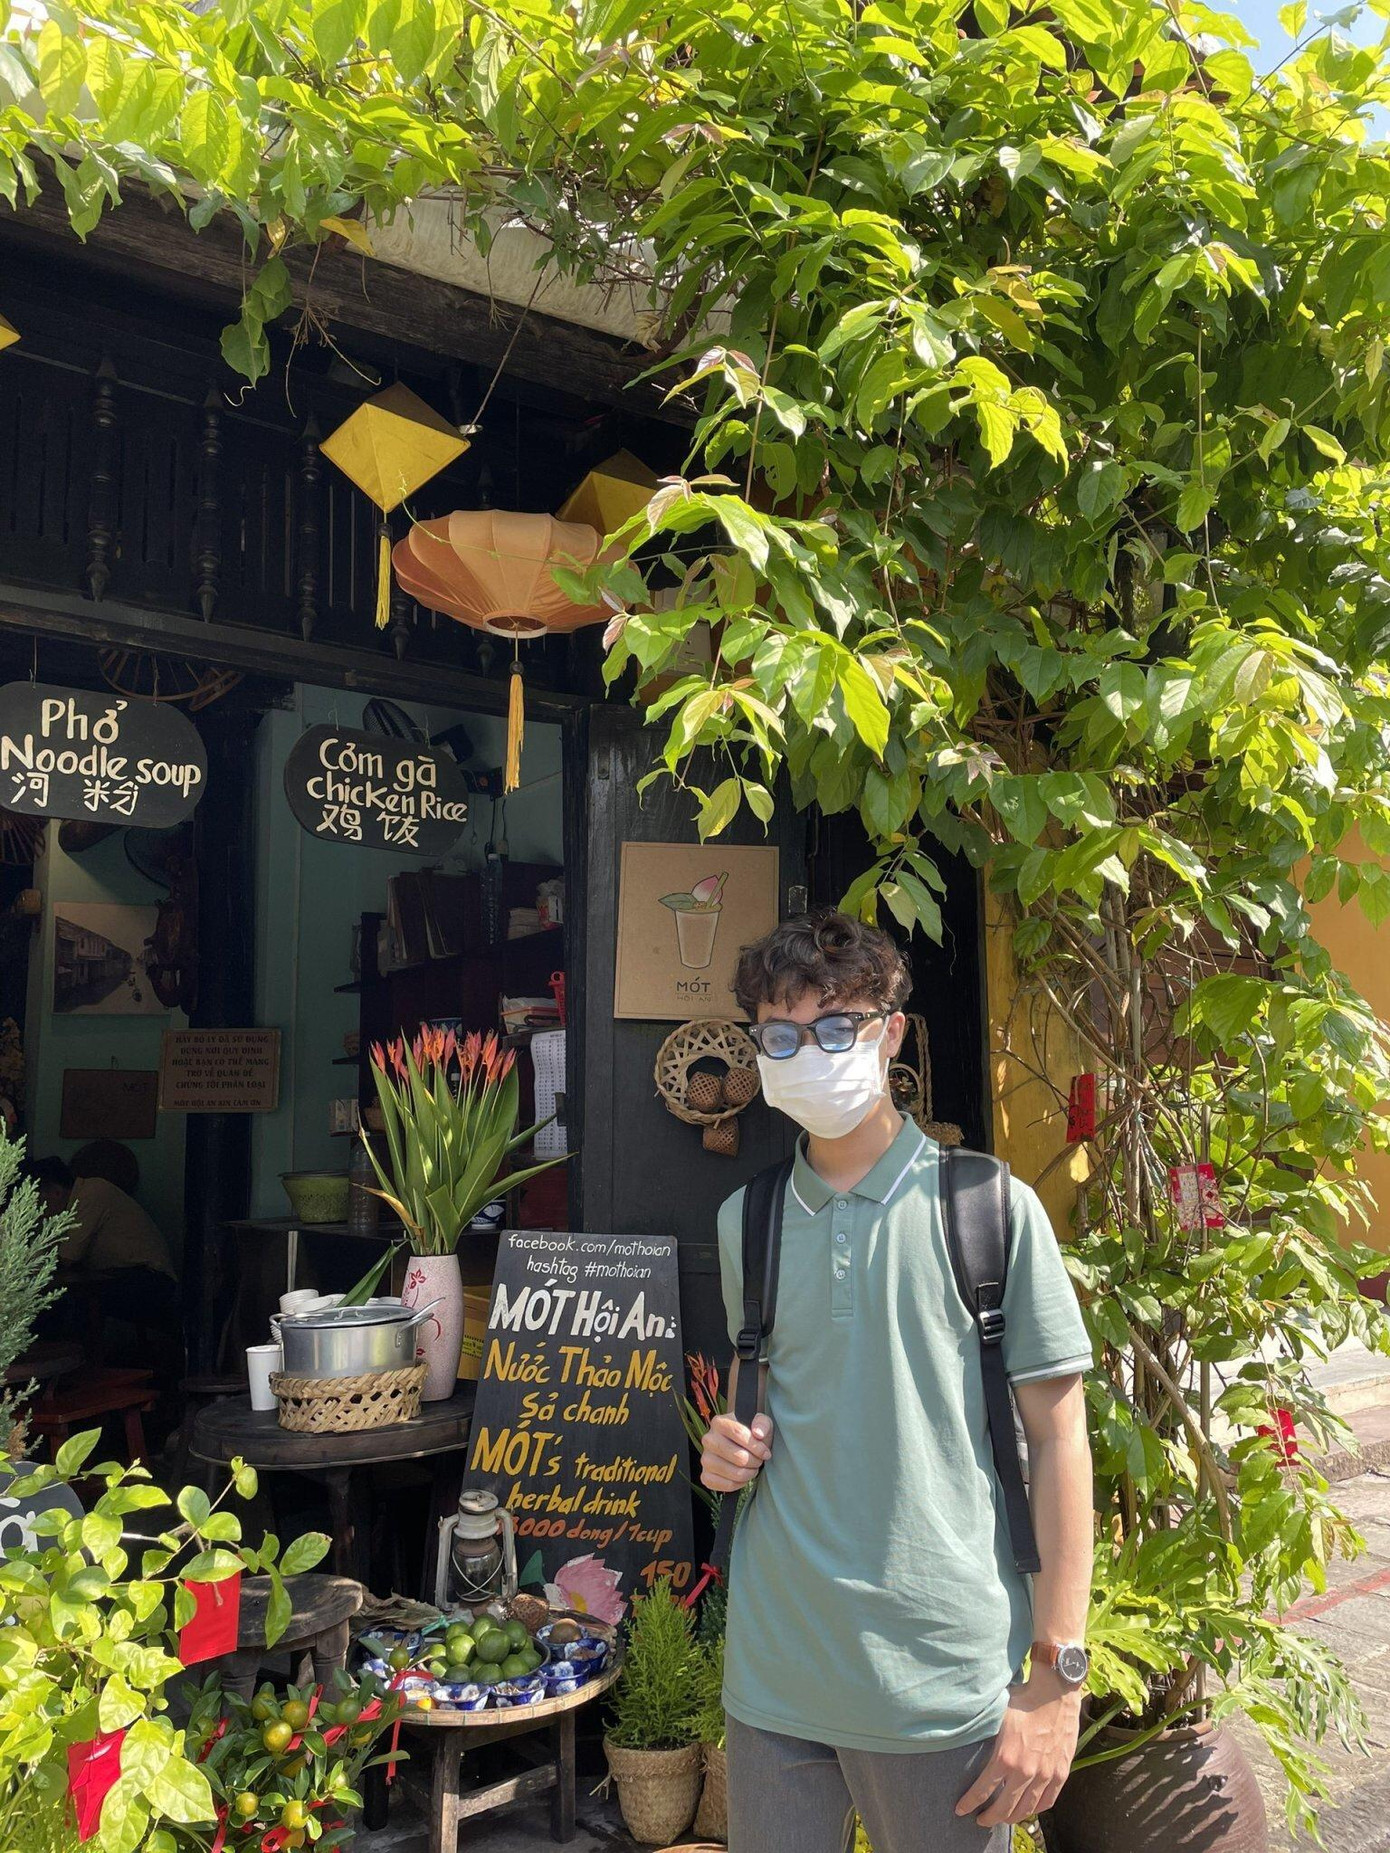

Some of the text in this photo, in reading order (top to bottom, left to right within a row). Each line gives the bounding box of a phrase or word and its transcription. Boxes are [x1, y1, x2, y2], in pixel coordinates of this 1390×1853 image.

[41, 697, 128, 745] Phở
[1, 734, 128, 781] Noodle
[420, 790, 468, 822] Rice
[676, 976, 711, 993] MÓT
[526, 1255, 652, 1283] hashtag #mothoian
[488, 1278, 577, 1335] MÓT
[569, 1290, 621, 1343] Hội
[558, 1345, 622, 1388] Thảo
[518, 1390, 631, 1425] Sả chanh
[574, 1452, 679, 1485] traditional
[505, 1481, 641, 1518] herbal drink
